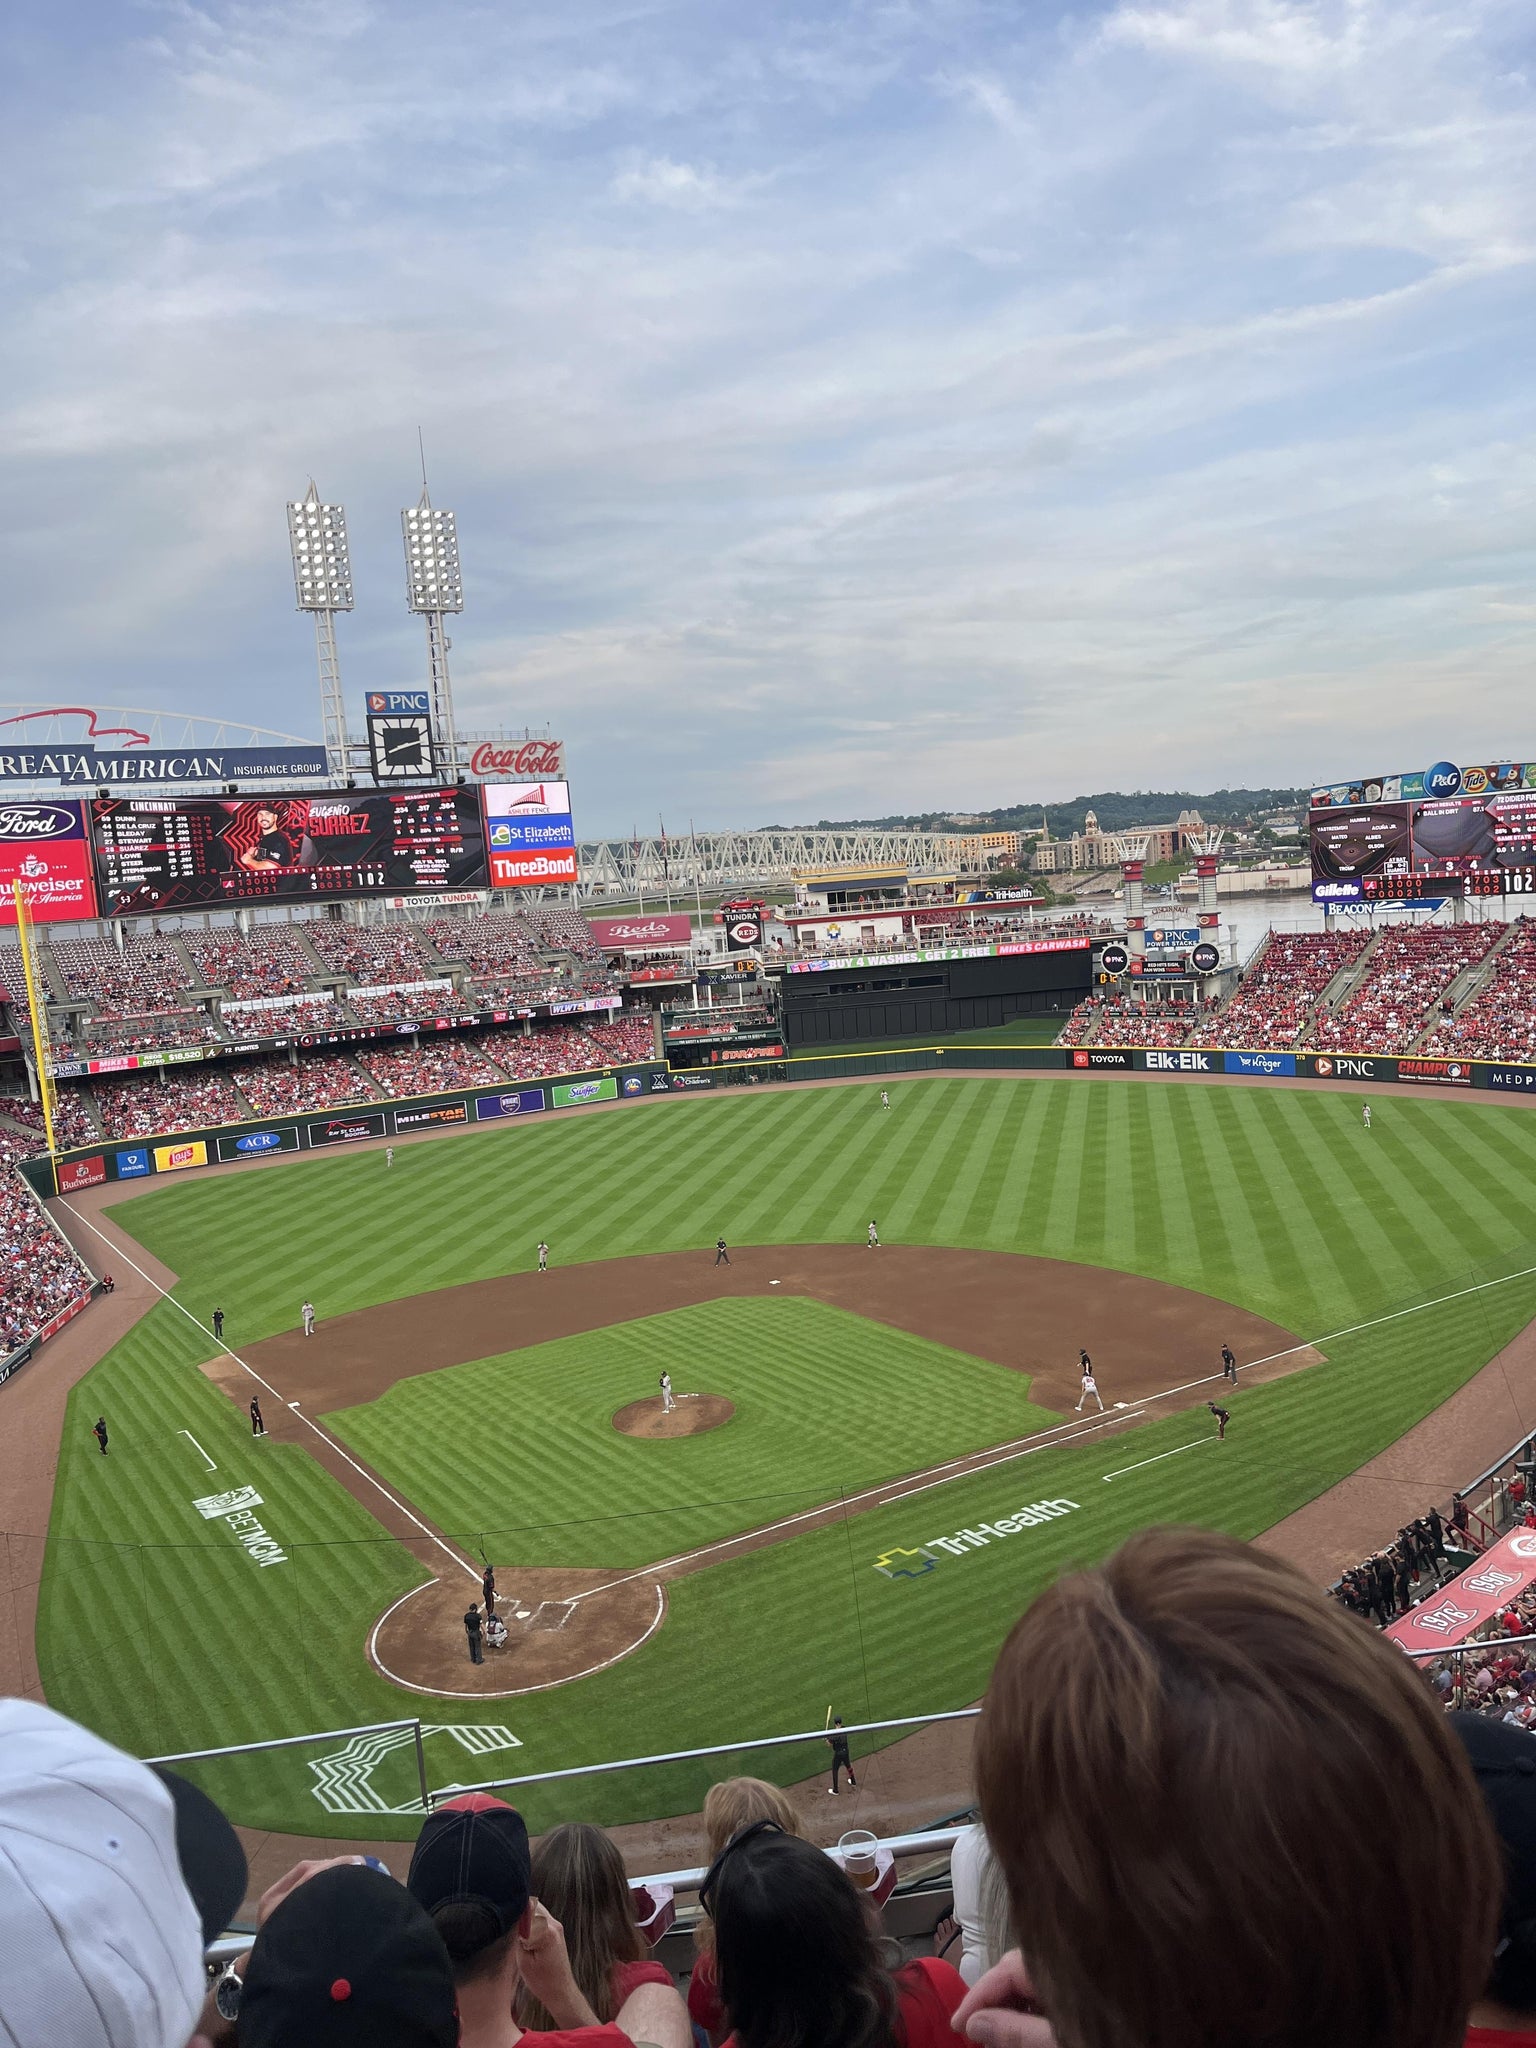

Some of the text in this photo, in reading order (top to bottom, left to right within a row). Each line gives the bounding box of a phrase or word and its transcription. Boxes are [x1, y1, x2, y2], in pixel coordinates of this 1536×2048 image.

[388, 694, 428, 710] PNC
[471, 741, 563, 775] Coca-Cola
[69, 756, 224, 780] AMERICAN
[234, 764, 322, 775] INSURANCE GROUP
[1431, 772, 1457, 786] P&G
[1464, 772, 1487, 789] Tide
[130, 802, 176, 812] CINCINNATI
[309, 804, 350, 818] EUGENIO
[0, 810, 56, 834] Ford
[511, 825, 571, 838] St. Elizabeth
[493, 855, 575, 878] ThreeBond
[1446, 860, 1478, 871] 3 4
[368, 872, 374, 885] 0
[378, 872, 385, 885] 2
[1514, 875, 1522, 891] 0
[1525, 875, 1533, 890] 2
[994, 889, 1032, 900] TriHealth
[1315, 884, 1359, 897] Gillette
[34, 892, 83, 904] America
[406, 893, 478, 905] TOYOTA TUNDRA
[1152, 906, 1189, 915] CINCINNATI
[1328, 903, 1373, 915] BEACON
[726, 913, 758, 922] TUNDRA
[608, 922, 670, 938] Reds
[1166, 931, 1190, 941] PNC
[999, 939, 1087, 954] MIKE'S CARWASH
[828, 958, 853, 970] BUY
[856, 957, 864, 967] 4
[867, 954, 920, 967] WASHES,
[925, 952, 946, 961] GET
[951, 950, 958, 959] 2
[961, 947, 990, 958] FREE
[594, 999, 614, 1008] ROSE
[235, 1044, 259, 1052] FUENTES
[168, 1052, 201, 1061] $18,520
[1091, 1055, 1125, 1063] TOYOTA
[1146, 1052, 1210, 1070] Elk+Elk
[1252, 1055, 1282, 1072] Kroger
[1334, 1059, 1374, 1077] PNC
[1492, 1073, 1536, 1085] MEDP
[568, 1084, 599, 1098] Swiffer
[397, 1108, 464, 1124] MILESTAR
[345, 1130, 370, 1138] ROOFING
[245, 1135, 271, 1148] ACR
[122, 1163, 145, 1172] FANDUEL
[62, 1172, 104, 1190] Budweiser
[924, 1498, 1081, 1555] TriHealth
[225, 1510, 288, 1567] BETMGM
[1468, 1572, 1514, 1593] 1990
[1420, 1608, 1469, 1632] 1976
